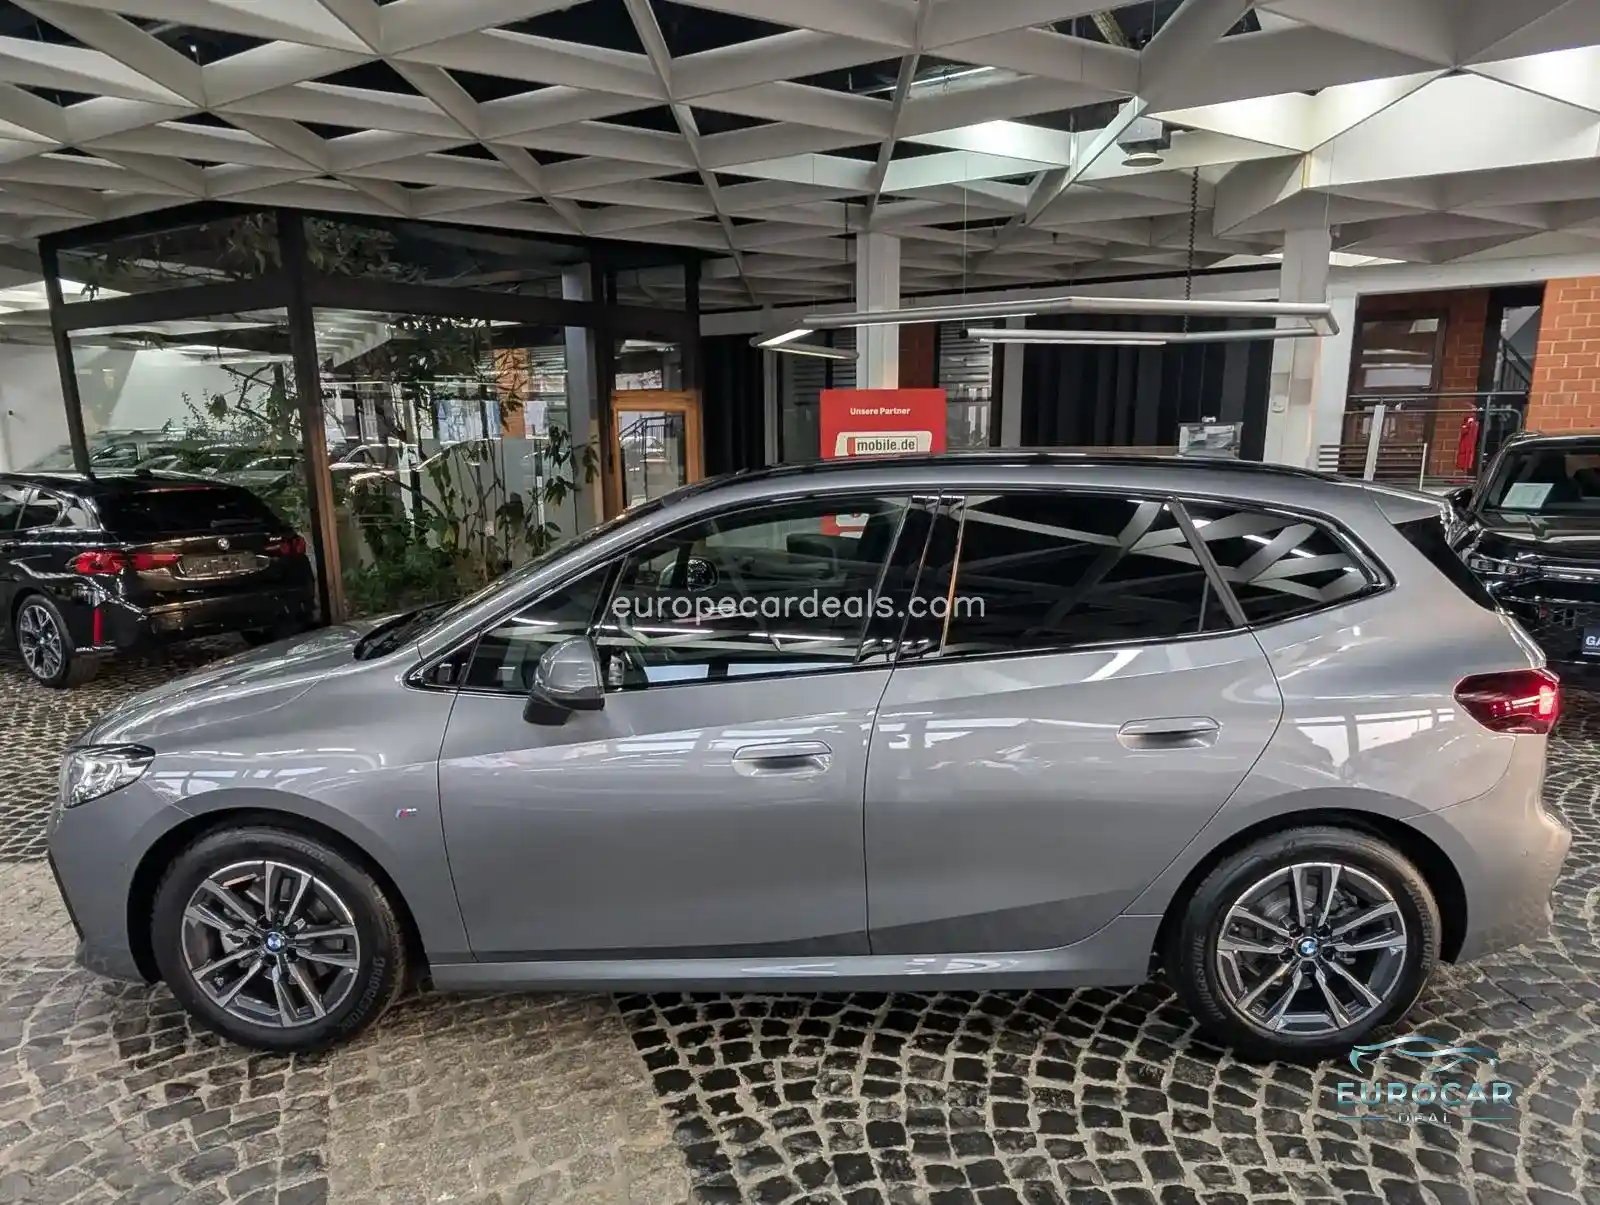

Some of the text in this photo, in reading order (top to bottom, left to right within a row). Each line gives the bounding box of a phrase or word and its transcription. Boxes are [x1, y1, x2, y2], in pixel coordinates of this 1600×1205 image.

[850, 407, 911, 416] Unsere Partner
[857, 439, 915, 451] mobile.de
